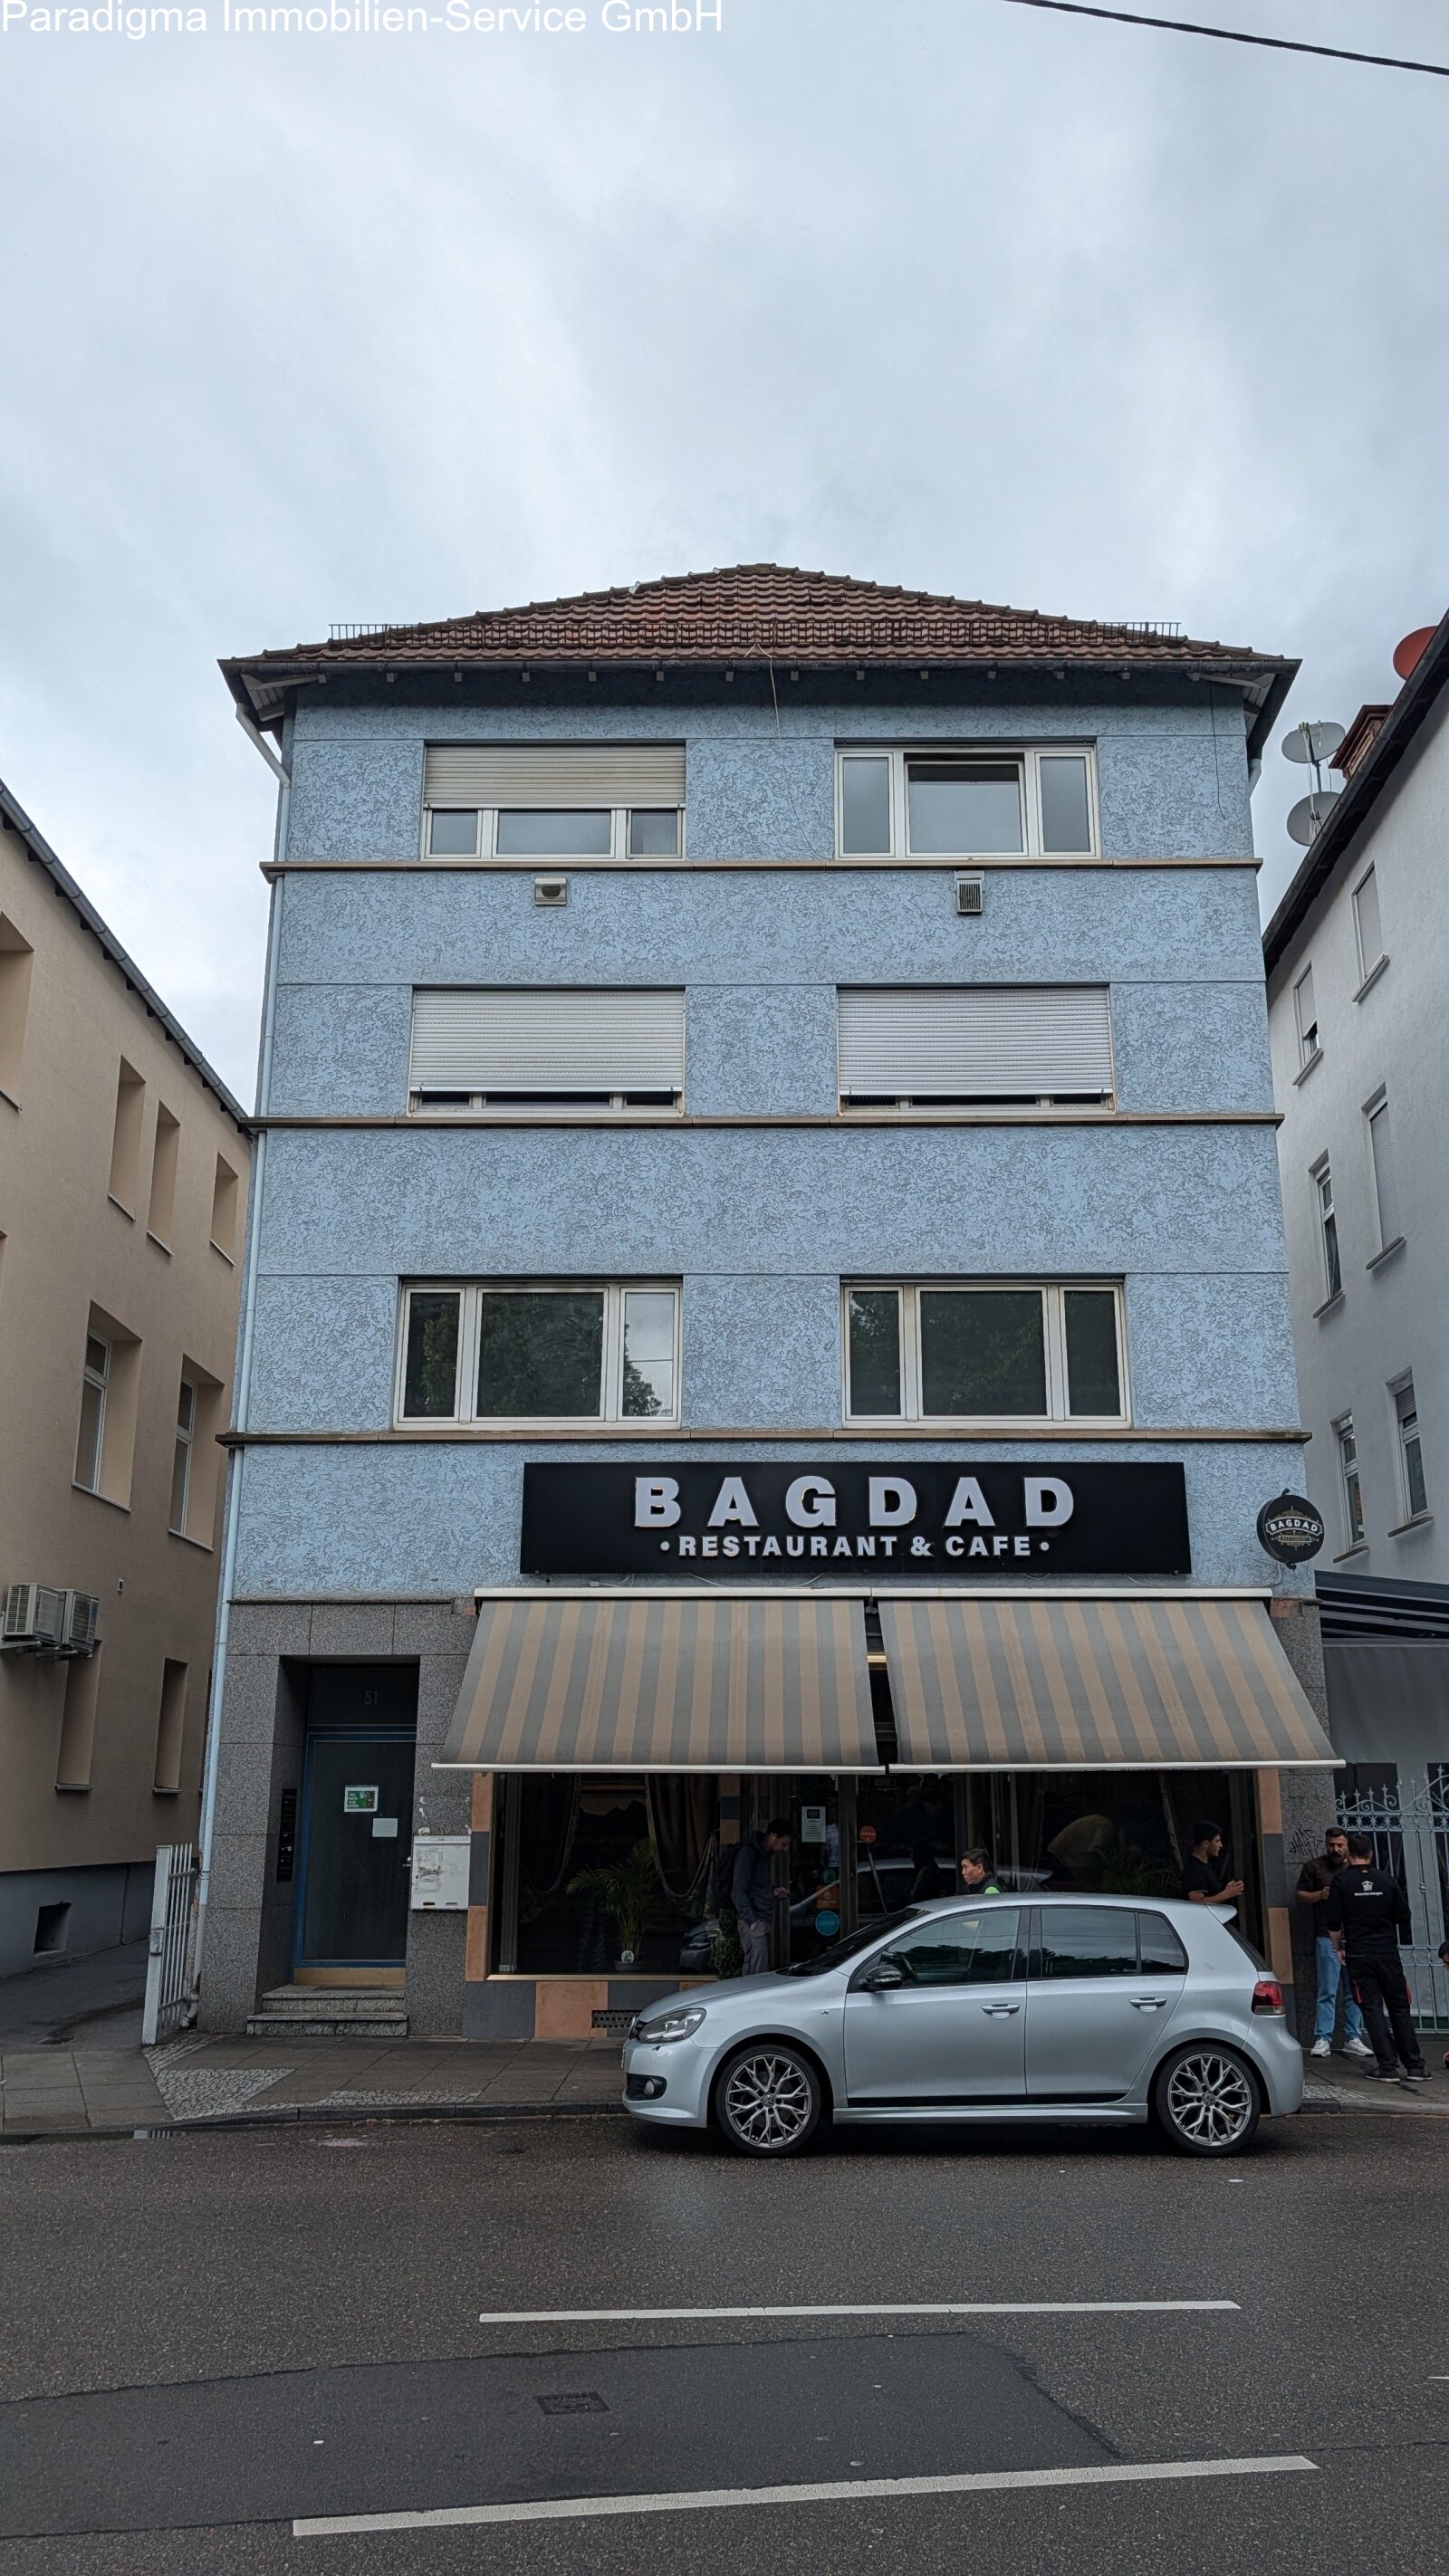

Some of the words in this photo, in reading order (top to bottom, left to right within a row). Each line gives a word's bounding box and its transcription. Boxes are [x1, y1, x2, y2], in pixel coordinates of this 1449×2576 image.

[634, 1475, 1075, 1528] BAGDAD
[1270, 1518, 1319, 1532] BAGDAD
[677, 1536, 897, 1557] RESTAURANT
[910, 1536, 932, 1557] &
[945, 1536, 1031, 1557] CAFE
[365, 1690, 378, 1706] 51
